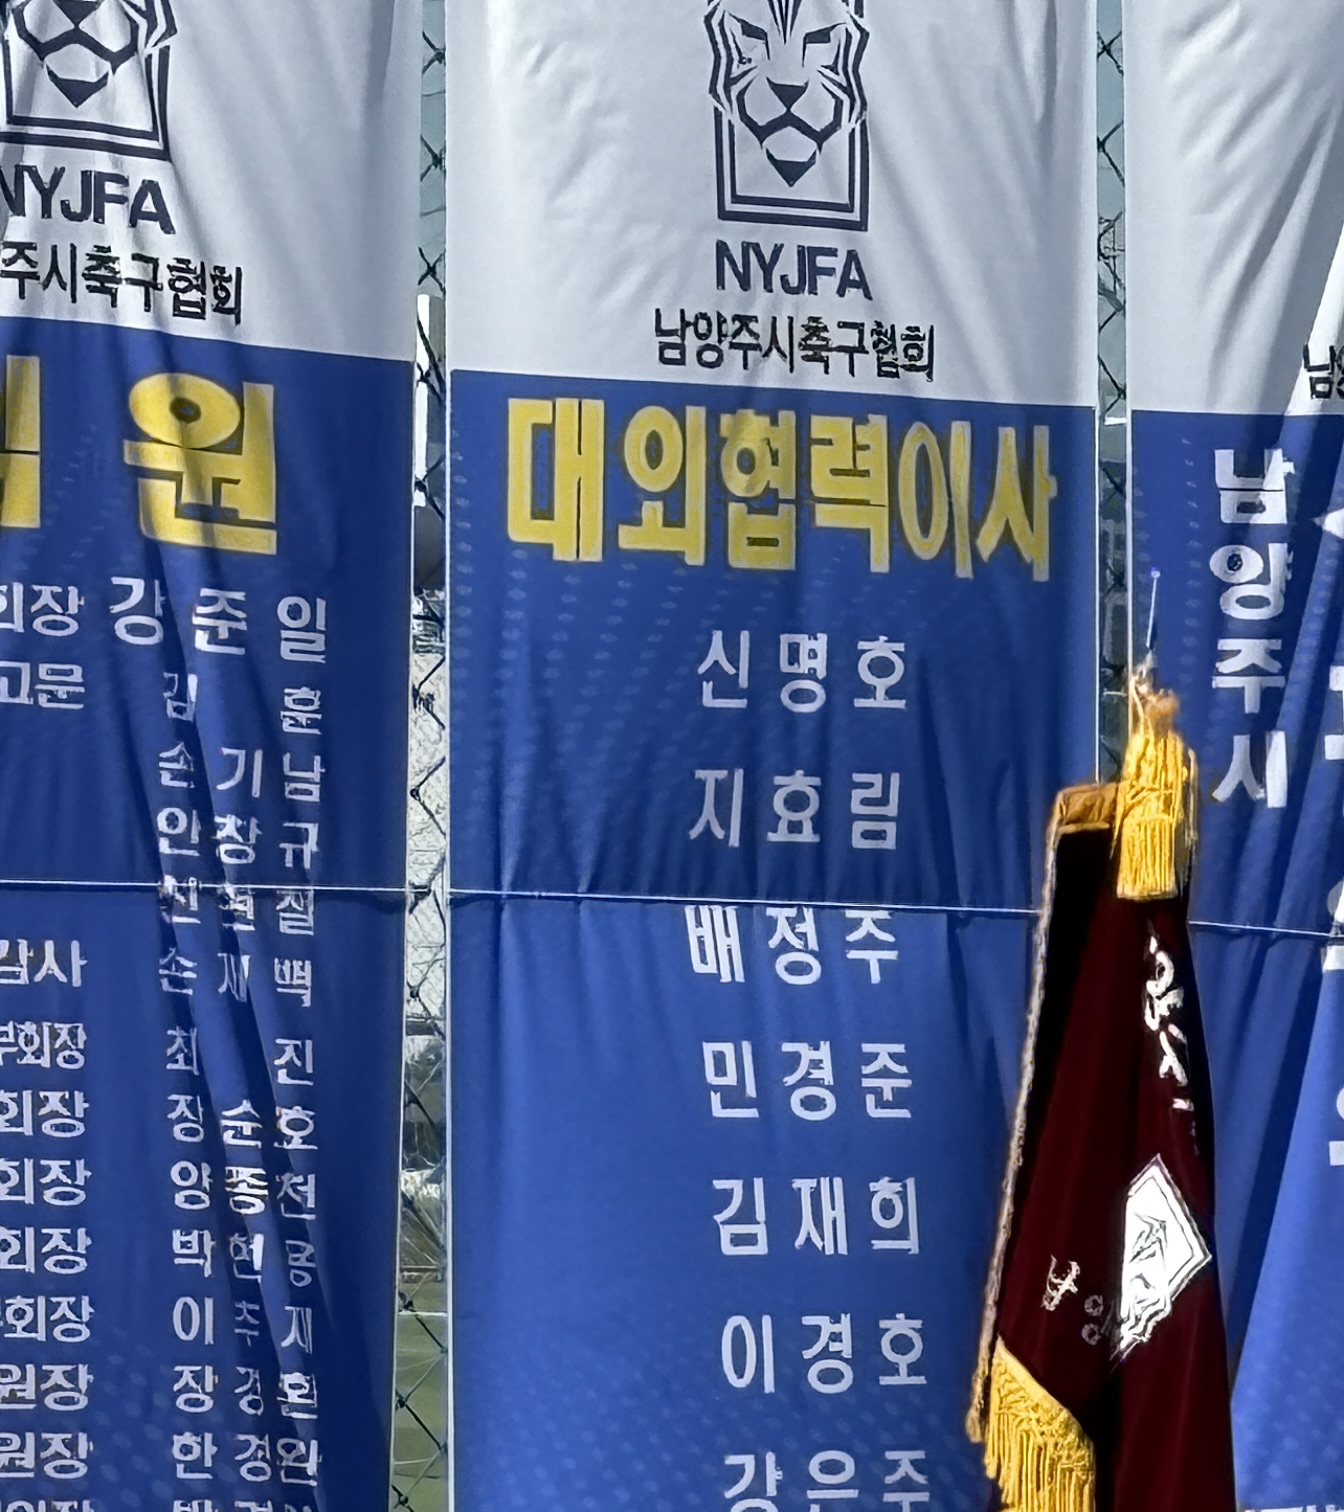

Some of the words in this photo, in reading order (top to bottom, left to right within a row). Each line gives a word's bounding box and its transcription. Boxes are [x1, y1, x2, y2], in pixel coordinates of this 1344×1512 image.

[714, 239, 874, 300] NYJFA
[654, 307, 935, 382] 남양주시축구협회
[507, 397, 1058, 582] 대외협력이사
[1209, 448, 1295, 808] 남양주시
